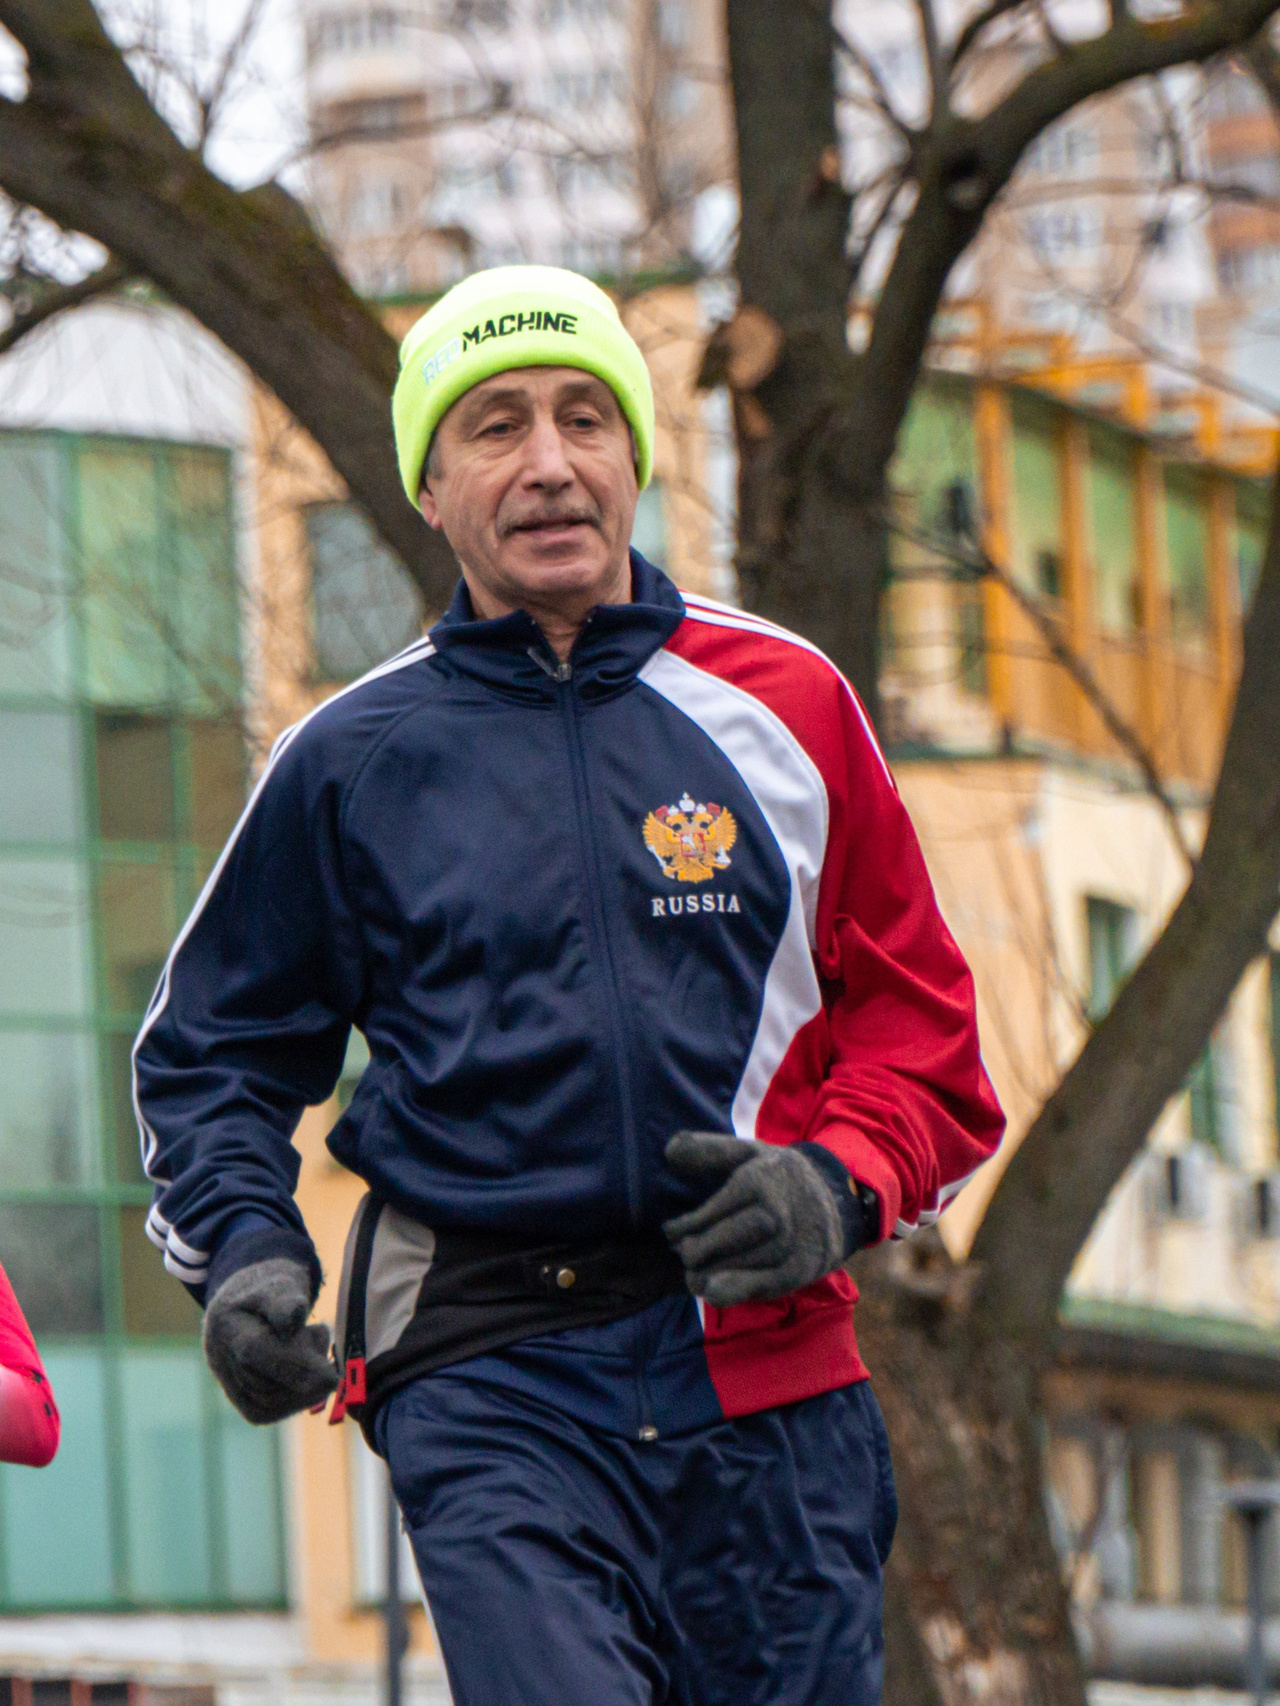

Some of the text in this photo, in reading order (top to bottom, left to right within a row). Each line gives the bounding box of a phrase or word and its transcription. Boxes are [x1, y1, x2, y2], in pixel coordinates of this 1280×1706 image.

[422, 311, 578, 387] RED MACHINE
[651, 894, 741, 917] RUSSIA
